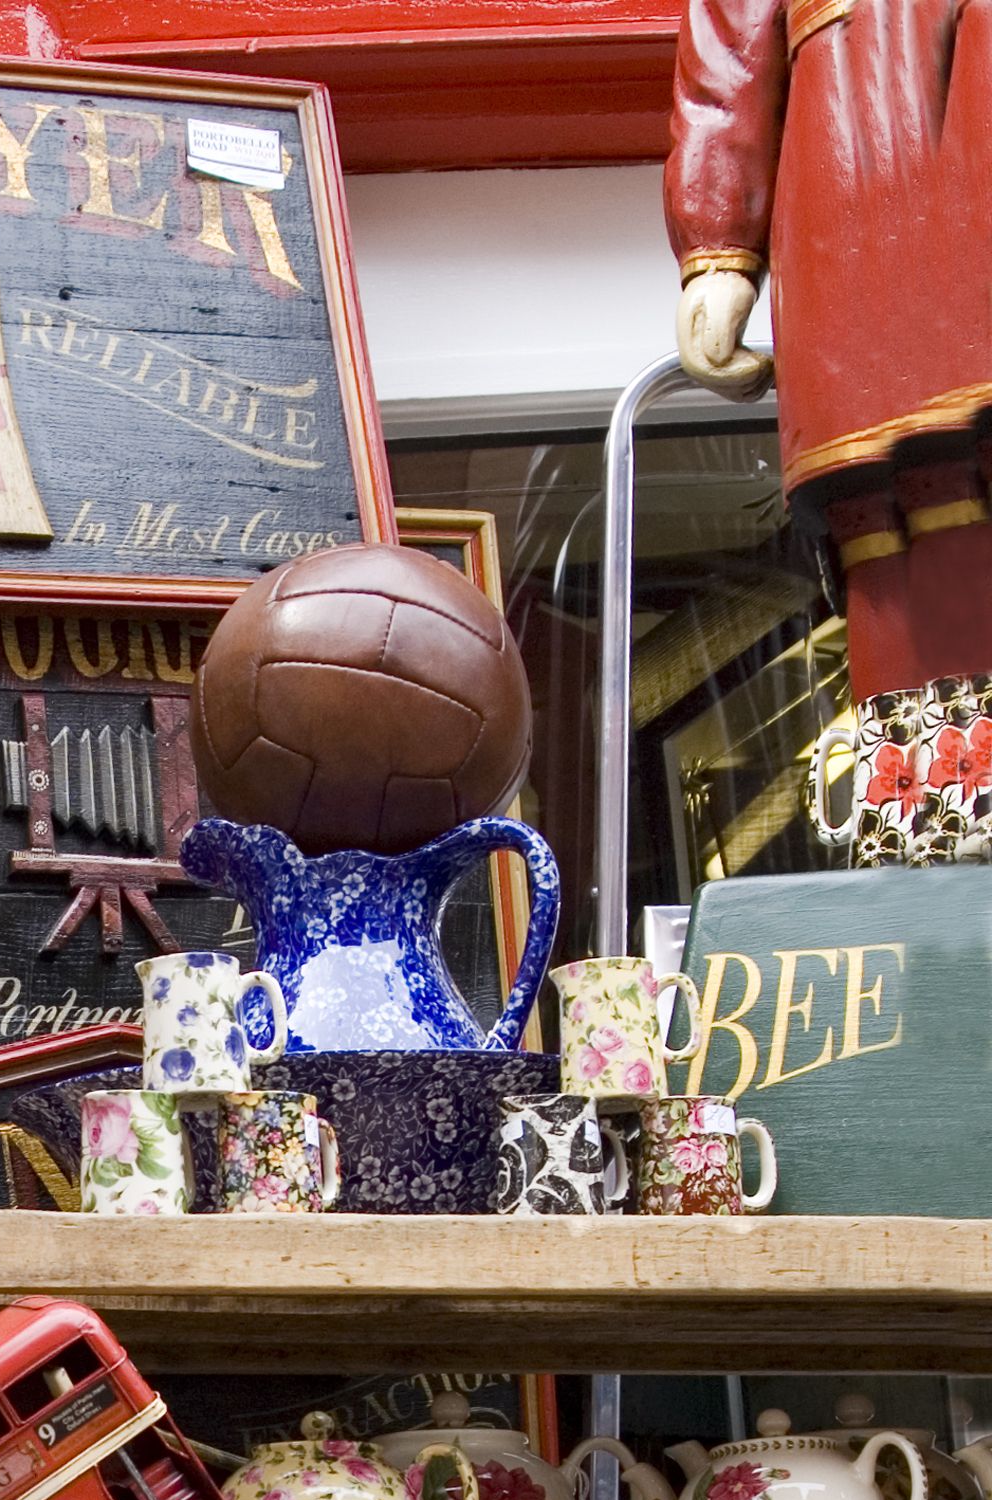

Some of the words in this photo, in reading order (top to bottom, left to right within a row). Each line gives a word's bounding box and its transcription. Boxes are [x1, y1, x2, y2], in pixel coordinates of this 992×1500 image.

[192, 138, 229, 152] ROAD
[193, 129, 276, 150] PORTOBELLO
[15, 306, 322, 450] RELIABLE
[60, 498, 108, 546] In
[114, 500, 231, 556] Most
[237, 508, 346, 557] Cases
[684, 942, 905, 1103] BEE
[38, 1423, 56, 1446] 9
